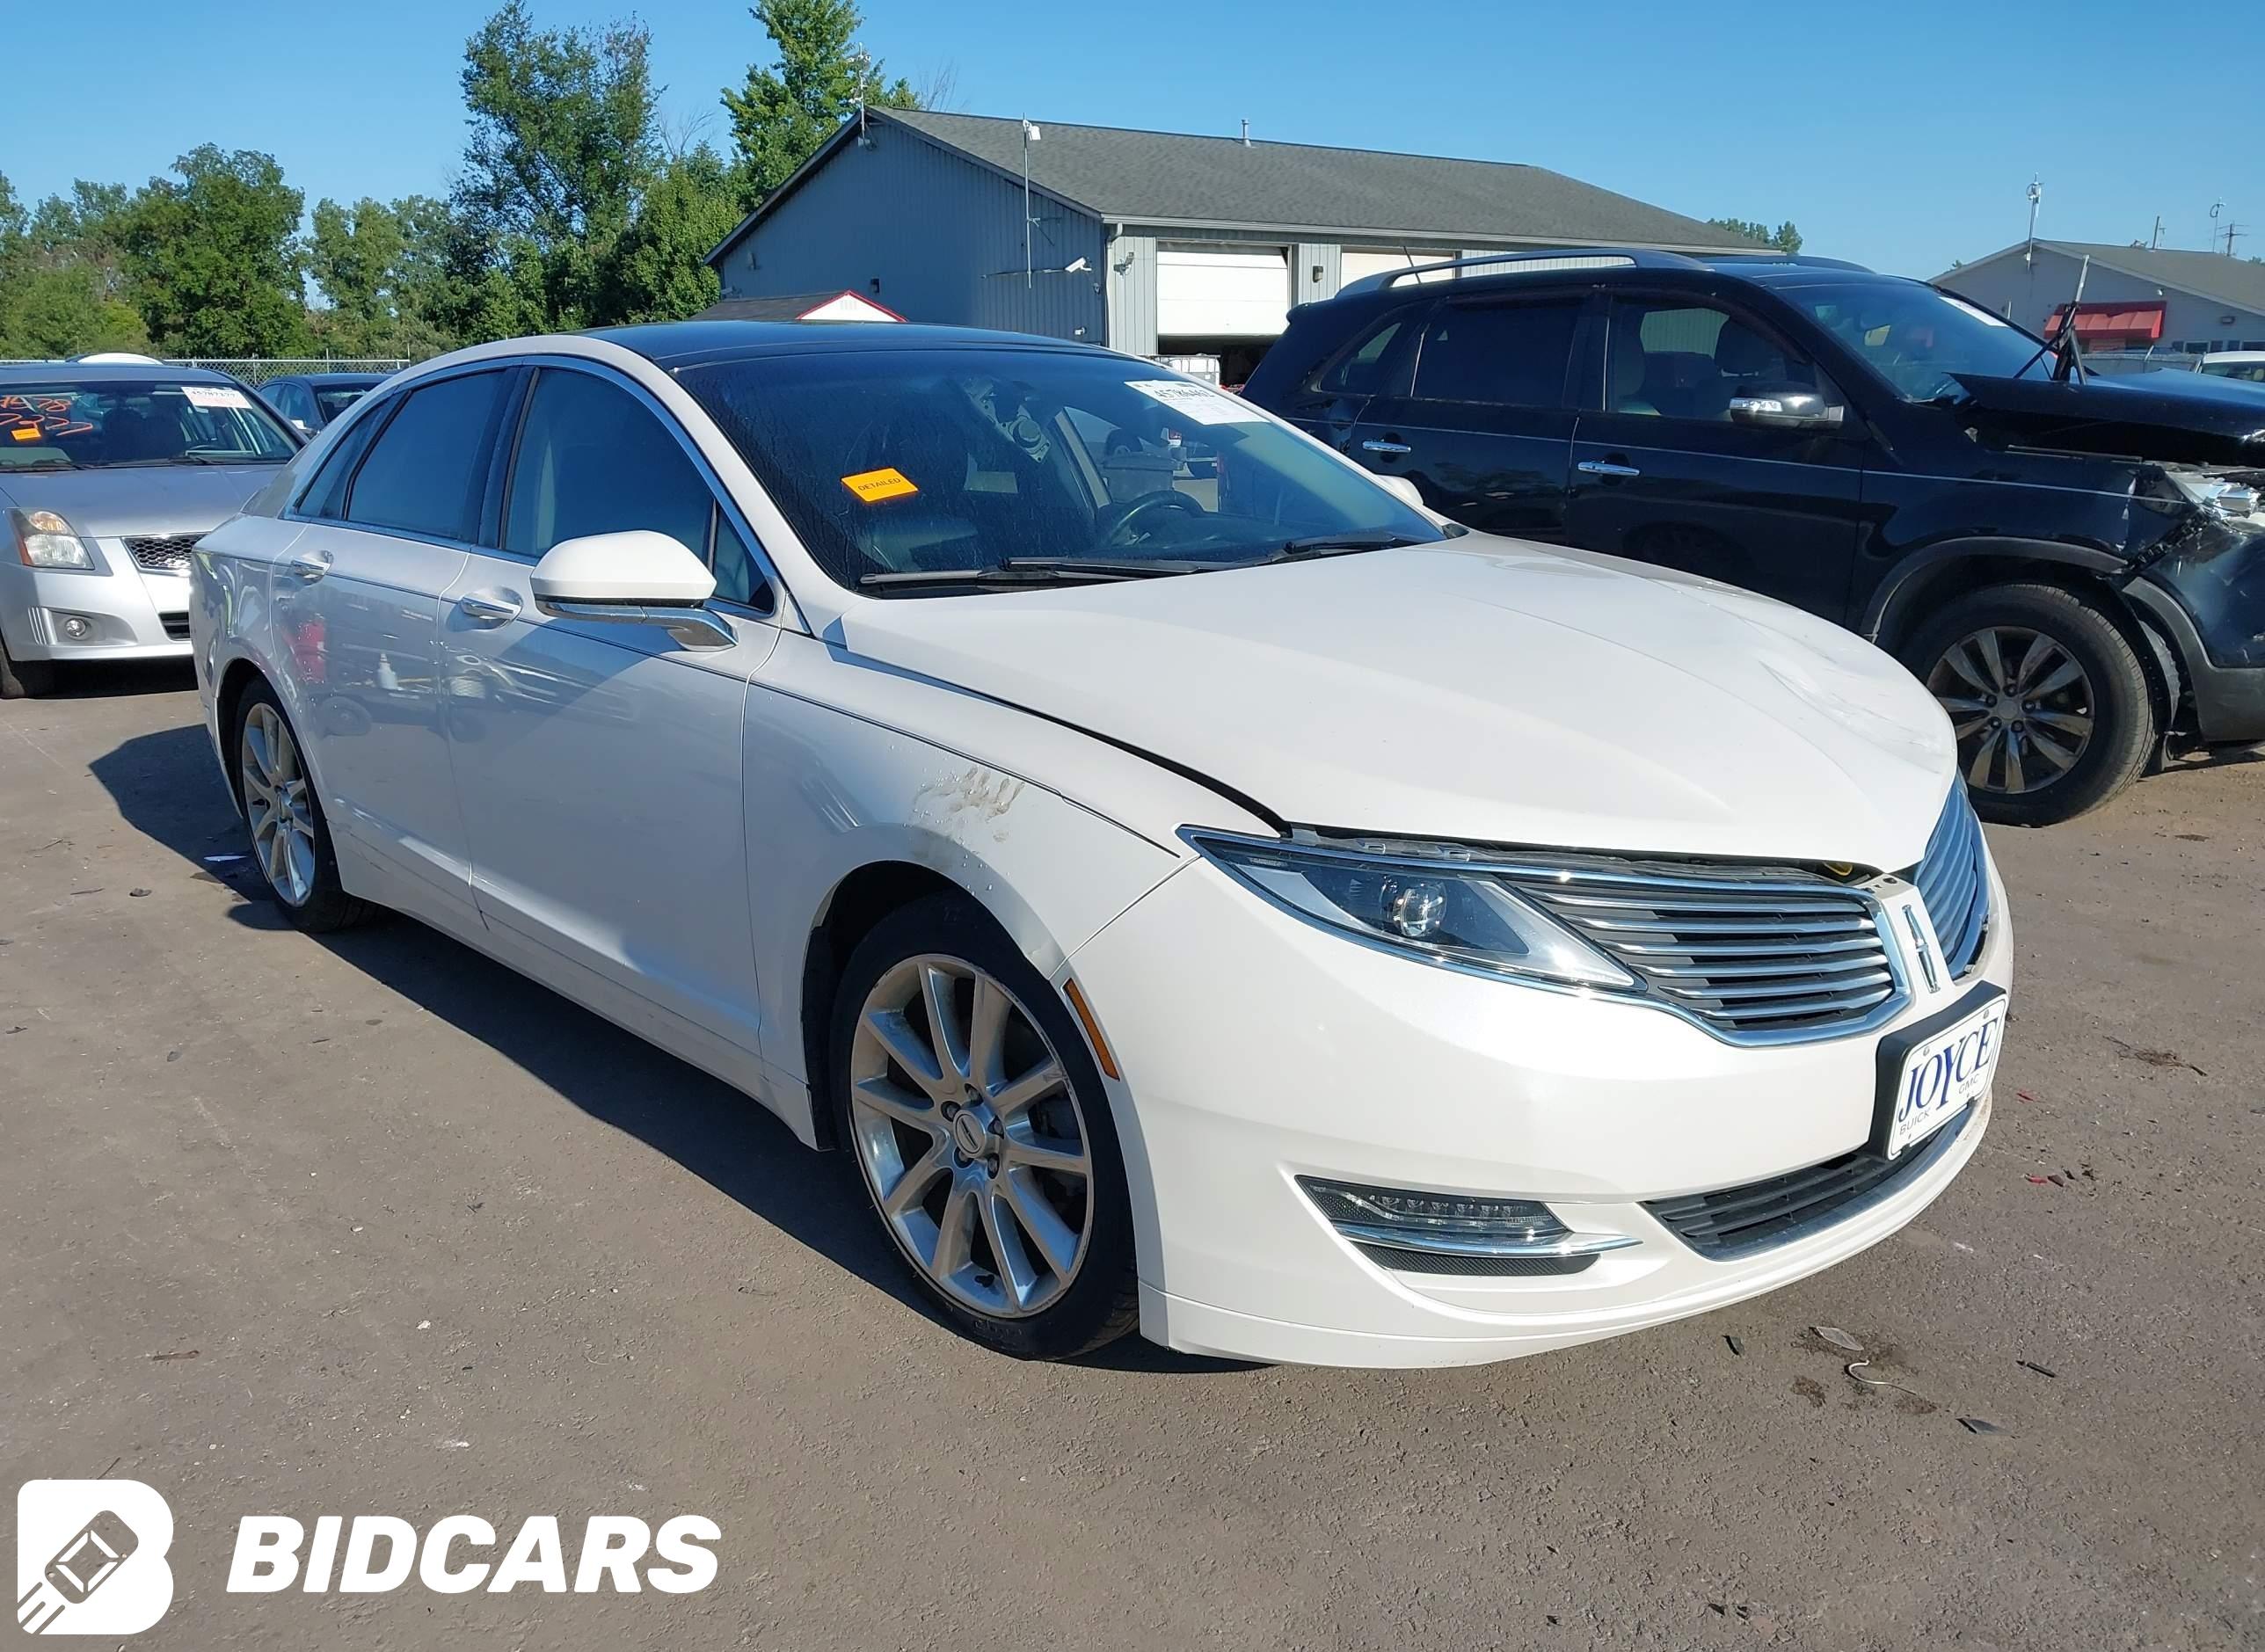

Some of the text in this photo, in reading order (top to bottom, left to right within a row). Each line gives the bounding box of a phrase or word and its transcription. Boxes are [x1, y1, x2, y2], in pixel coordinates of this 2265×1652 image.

[857, 477, 901, 491] DETAILED
[1898, 1016, 1999, 1124] JOYCE
[1958, 1073, 1980, 1095] GMC
[1899, 1108, 1931, 1136] BUICK
